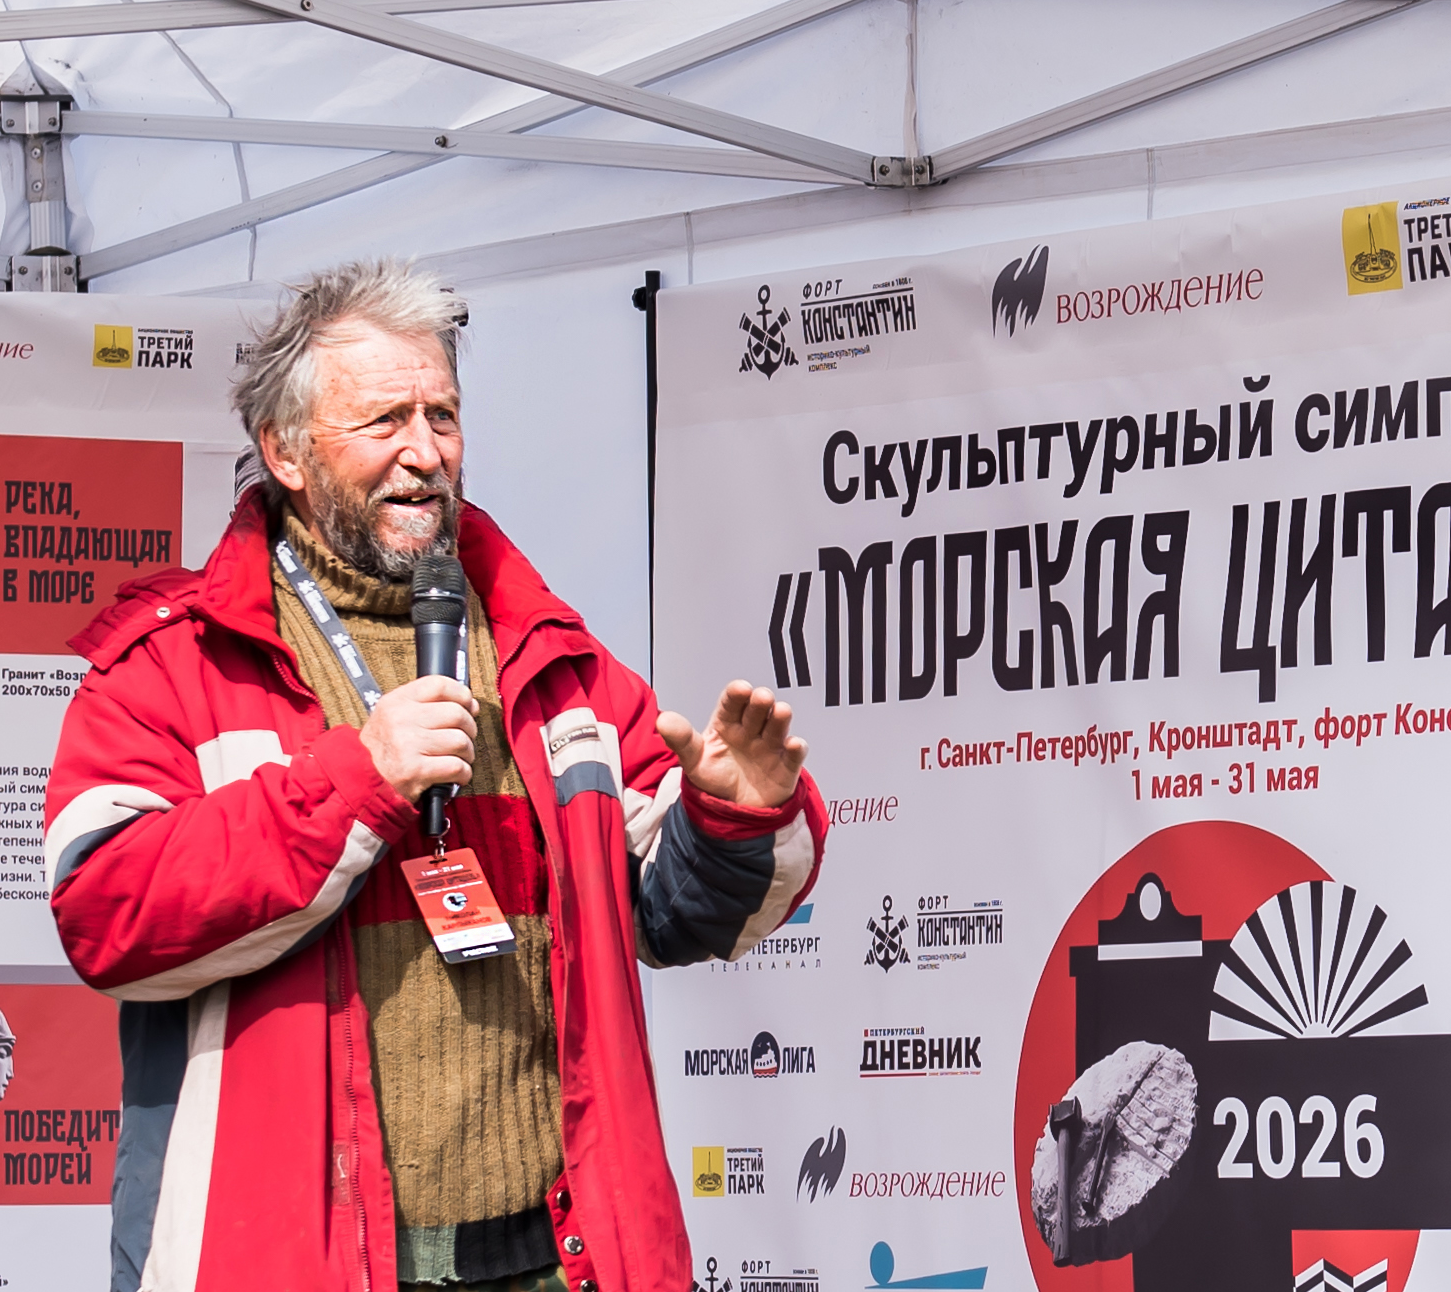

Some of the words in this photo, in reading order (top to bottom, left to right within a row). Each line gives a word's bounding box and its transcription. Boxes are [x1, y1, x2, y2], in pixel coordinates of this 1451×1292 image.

[803, 279, 843, 300] ФОРТ
[799, 293, 918, 346] КОНСТАНТИН
[137, 350, 192, 369] ПАРК
[138, 335, 193, 350] ТРЕТИЙ
[823, 375, 1274, 518] Скульптурный
[4, 480, 80, 520] РЕКА,
[4, 524, 172, 568] ВПАДАЮЩАЯ
[3, 568, 18, 602] В
[29, 570, 94, 604] МОРЕ
[768, 510, 1190, 707] «МОРСКАЯ
[921, 747, 931, 770] г.
[937, 724, 1139, 768] Санкт-Петербург,
[1149, 719, 1304, 752] Кронштадт,
[1314, 707, 1387, 749] форт
[1132, 769, 1140, 800] 1
[1151, 773, 1202, 799] мая
[1228, 762, 1254, 794] 31
[1267, 766, 1319, 792] мая
[918, 895, 948, 910] ФОРТ
[917, 914, 1003, 947] КОНСТАНТИН
[870, 1026, 924, 1036] ПЕТЕРБУРГСКИЙ
[685, 1048, 749, 1076] МОРСКАЯ
[782, 1046, 815, 1074] ЛИГА
[860, 1036, 981, 1071] ДНЕВНИК
[1213, 1094, 1385, 1179] 2026
[727, 1154, 764, 1172] ТРЕТИЙ
[728, 1174, 764, 1194] ПАРК
[742, 1260, 771, 1274] ФОРТ
